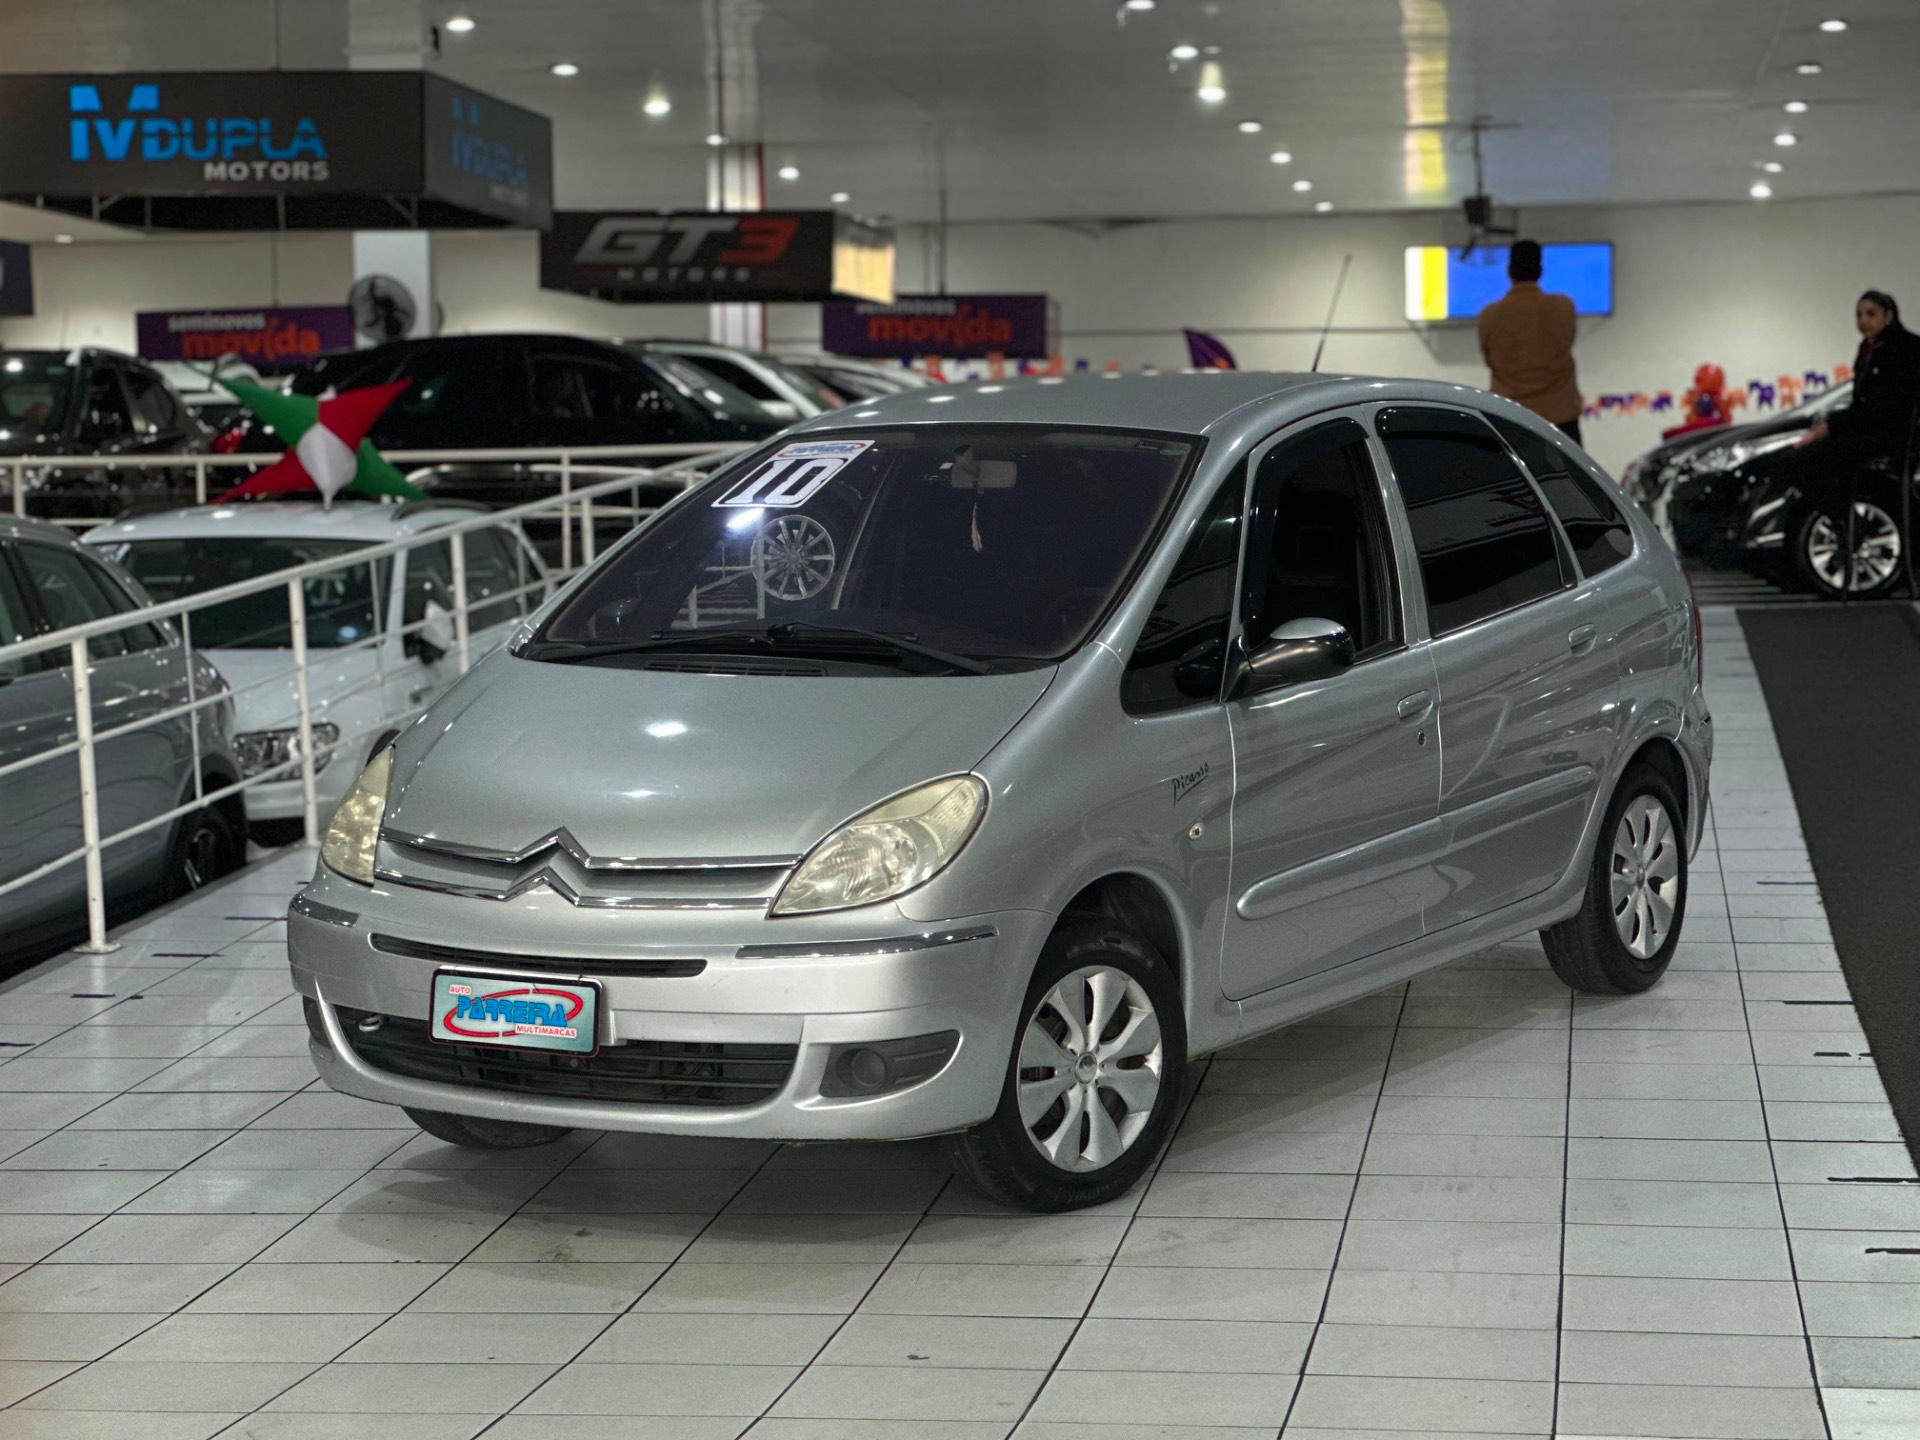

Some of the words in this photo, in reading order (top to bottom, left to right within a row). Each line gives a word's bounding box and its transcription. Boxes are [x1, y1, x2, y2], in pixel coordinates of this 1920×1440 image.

[204, 161, 330, 181] MOTORS
[573, 216, 798, 264] GT3
[616, 268, 750, 282] MOTORS
[168, 313, 267, 332] seminovos
[720, 457, 848, 505] 10
[450, 985, 471, 994] AUTO
[457, 996, 568, 1027] PARREIRA
[516, 1025, 576, 1037] MULTIMARCAS
